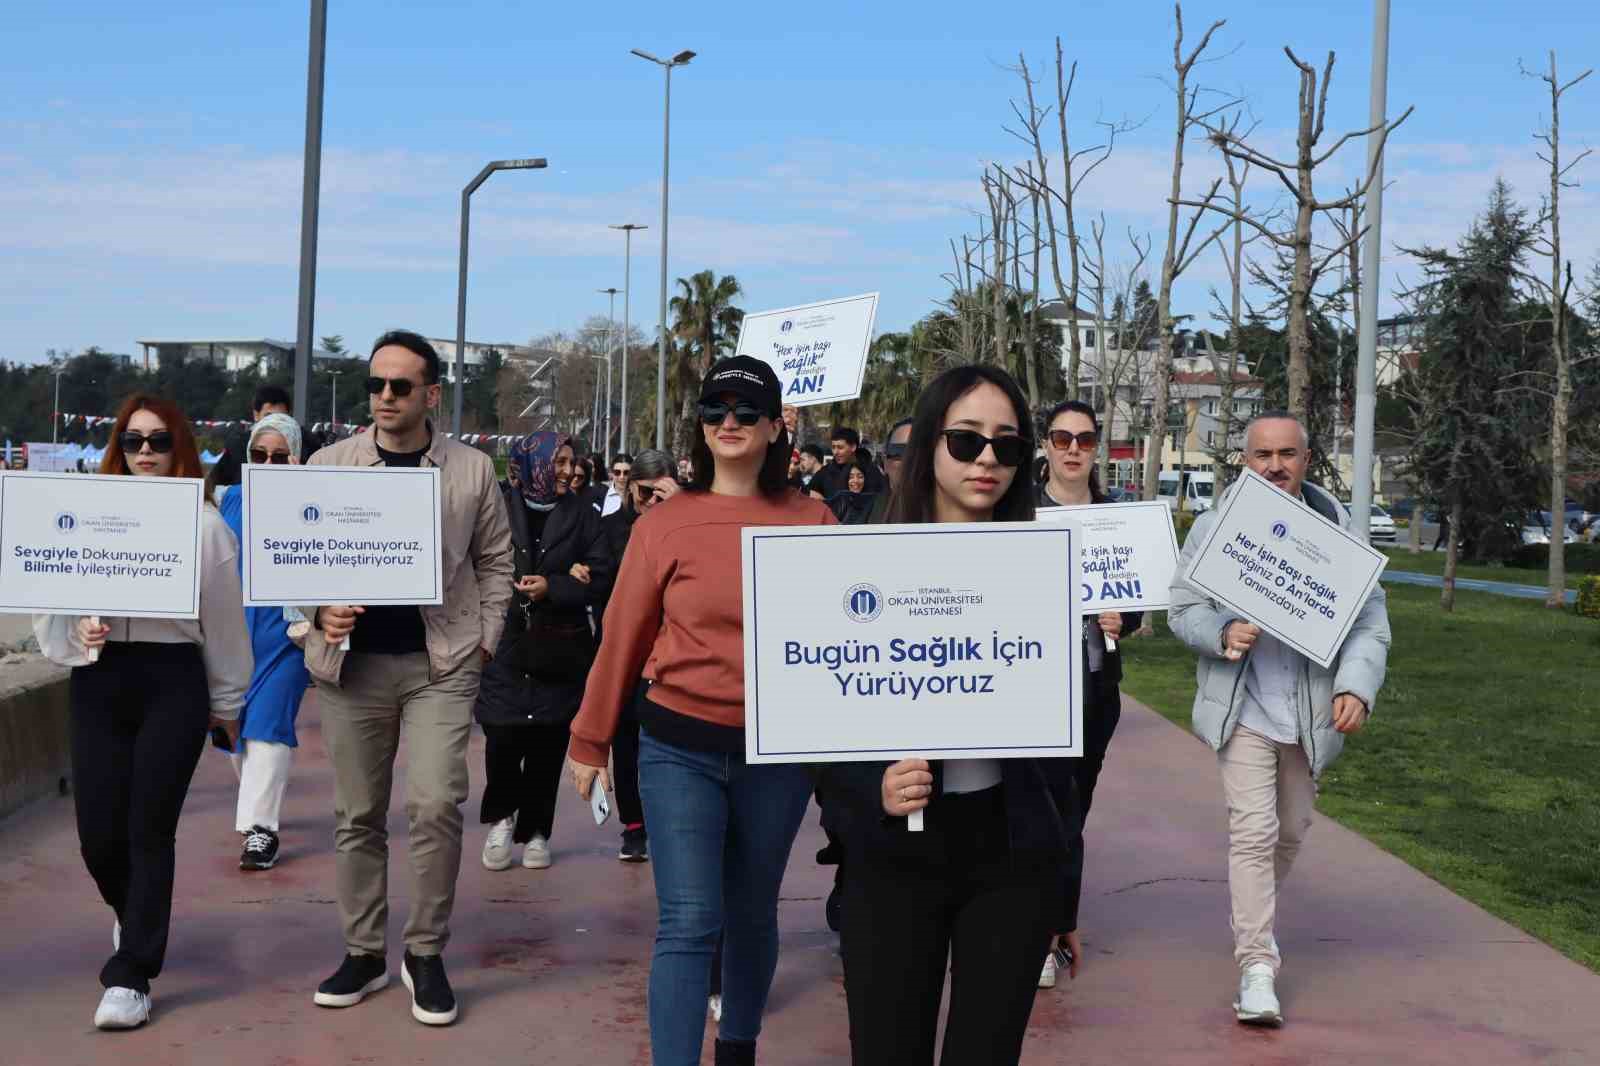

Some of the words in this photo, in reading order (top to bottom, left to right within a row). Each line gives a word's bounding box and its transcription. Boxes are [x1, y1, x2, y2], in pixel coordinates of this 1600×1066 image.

[786, 375, 825, 396] AN!
[15, 546, 78, 560] Sevgiyle
[82, 547, 183, 564] Dokunuyoruz,
[264, 538, 325, 552] Sevgiyle
[328, 538, 423, 552] Dokunuyoruz,
[24, 560, 73, 573] Bilimle
[76, 562, 173, 578] İyileştiriyoruz
[273, 553, 320, 565] Bilimle
[323, 553, 414, 568] İyileştiriyoruz
[1222, 542, 1273, 581] Dediğiniz
[1274, 576, 1286, 587] O
[1235, 532, 1257, 551] Her
[1257, 543, 1278, 566] İşin
[1278, 559, 1302, 580] Başı
[1304, 575, 1338, 602] Sağlık
[1100, 580, 1143, 600] AN!
[1238, 568, 1307, 620] Yanınızdayız
[888, 596, 918, 606] OKAN
[784, 639, 880, 670] Bugün
[889, 636, 983, 667] Sağlık
[992, 630, 1043, 667] İçin
[834, 672, 995, 700] Yürüyoruz
